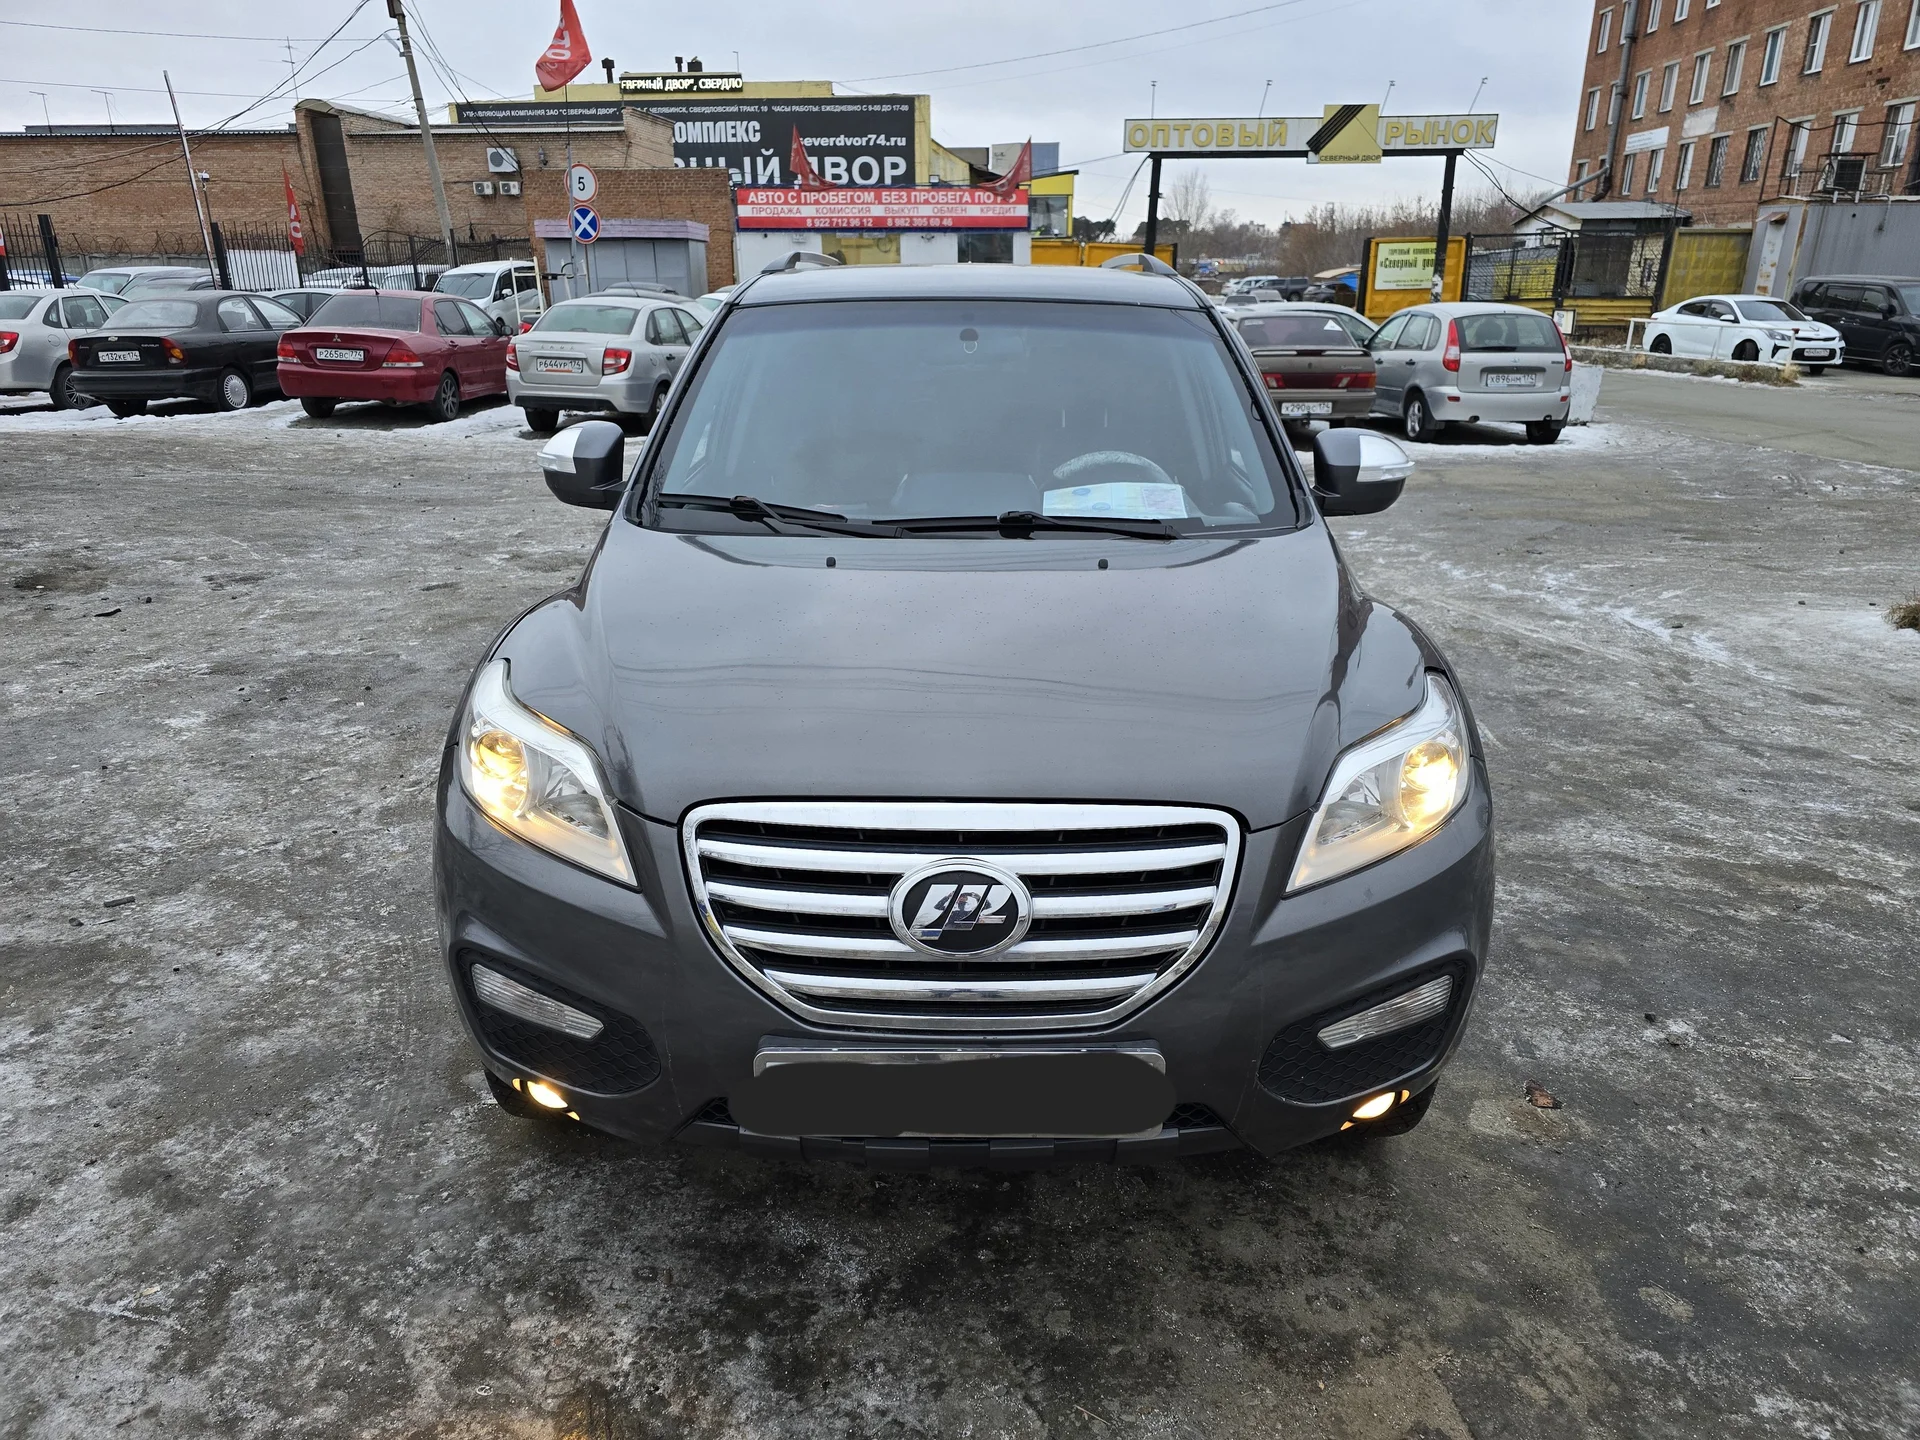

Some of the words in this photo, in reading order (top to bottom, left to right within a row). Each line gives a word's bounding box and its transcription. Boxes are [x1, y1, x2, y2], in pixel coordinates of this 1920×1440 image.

[698, 78, 742, 90] СВЕРДЛО
[511, 108, 545, 116] КОМПАНИЯ
[881, 104, 892, 112] ДО
[672, 121, 761, 143] ОМПЛЕКС
[1128, 119, 1288, 148] ОПТОВЫЙ
[1384, 119, 1496, 146] РЫНОК
[1320, 154, 1359, 162] СЕВЕРНЫЙ
[1361, 154, 1381, 162] ДВОР
[578, 176, 586, 192] 5
[748, 191, 785, 204] АВТО
[787, 191, 797, 204] С
[801, 191, 878, 205] ПРОБЕГОМ,
[881, 191, 907, 203] БЕЗ
[911, 191, 972, 203] ПРОБЕГА
[975, 191, 994, 203] ПО
[752, 207, 802, 217] ПРОДАЖА
[815, 206, 871, 216] КОМИССИЯ
[884, 206, 919, 215] ВЫКУП
[932, 206, 967, 215] ОБМЕН
[980, 206, 1017, 216] КРЕДИТ
[832, 218, 848, 227] 712
[862, 218, 873, 227] 12
